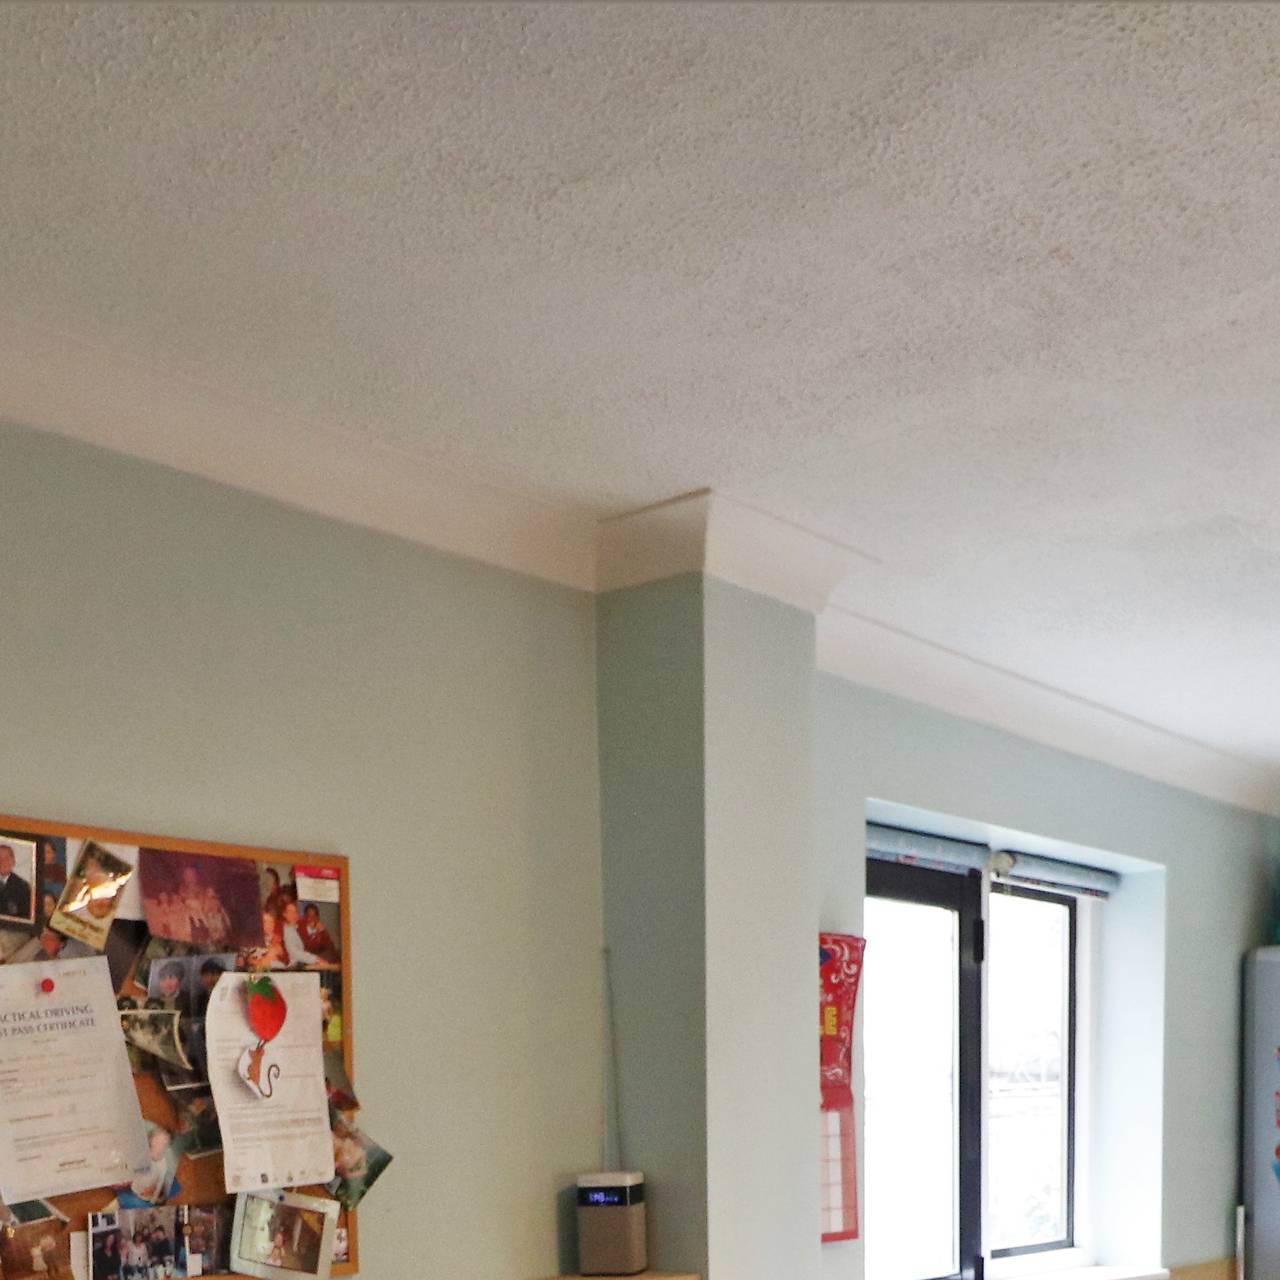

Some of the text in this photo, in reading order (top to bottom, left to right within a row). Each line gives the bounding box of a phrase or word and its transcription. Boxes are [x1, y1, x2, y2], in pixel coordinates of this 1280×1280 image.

[44, 1004, 94, 1018] DRIVING
[11, 1024, 35, 1036] PASS
[36, 1018, 96, 1034] CERTIFICATE
